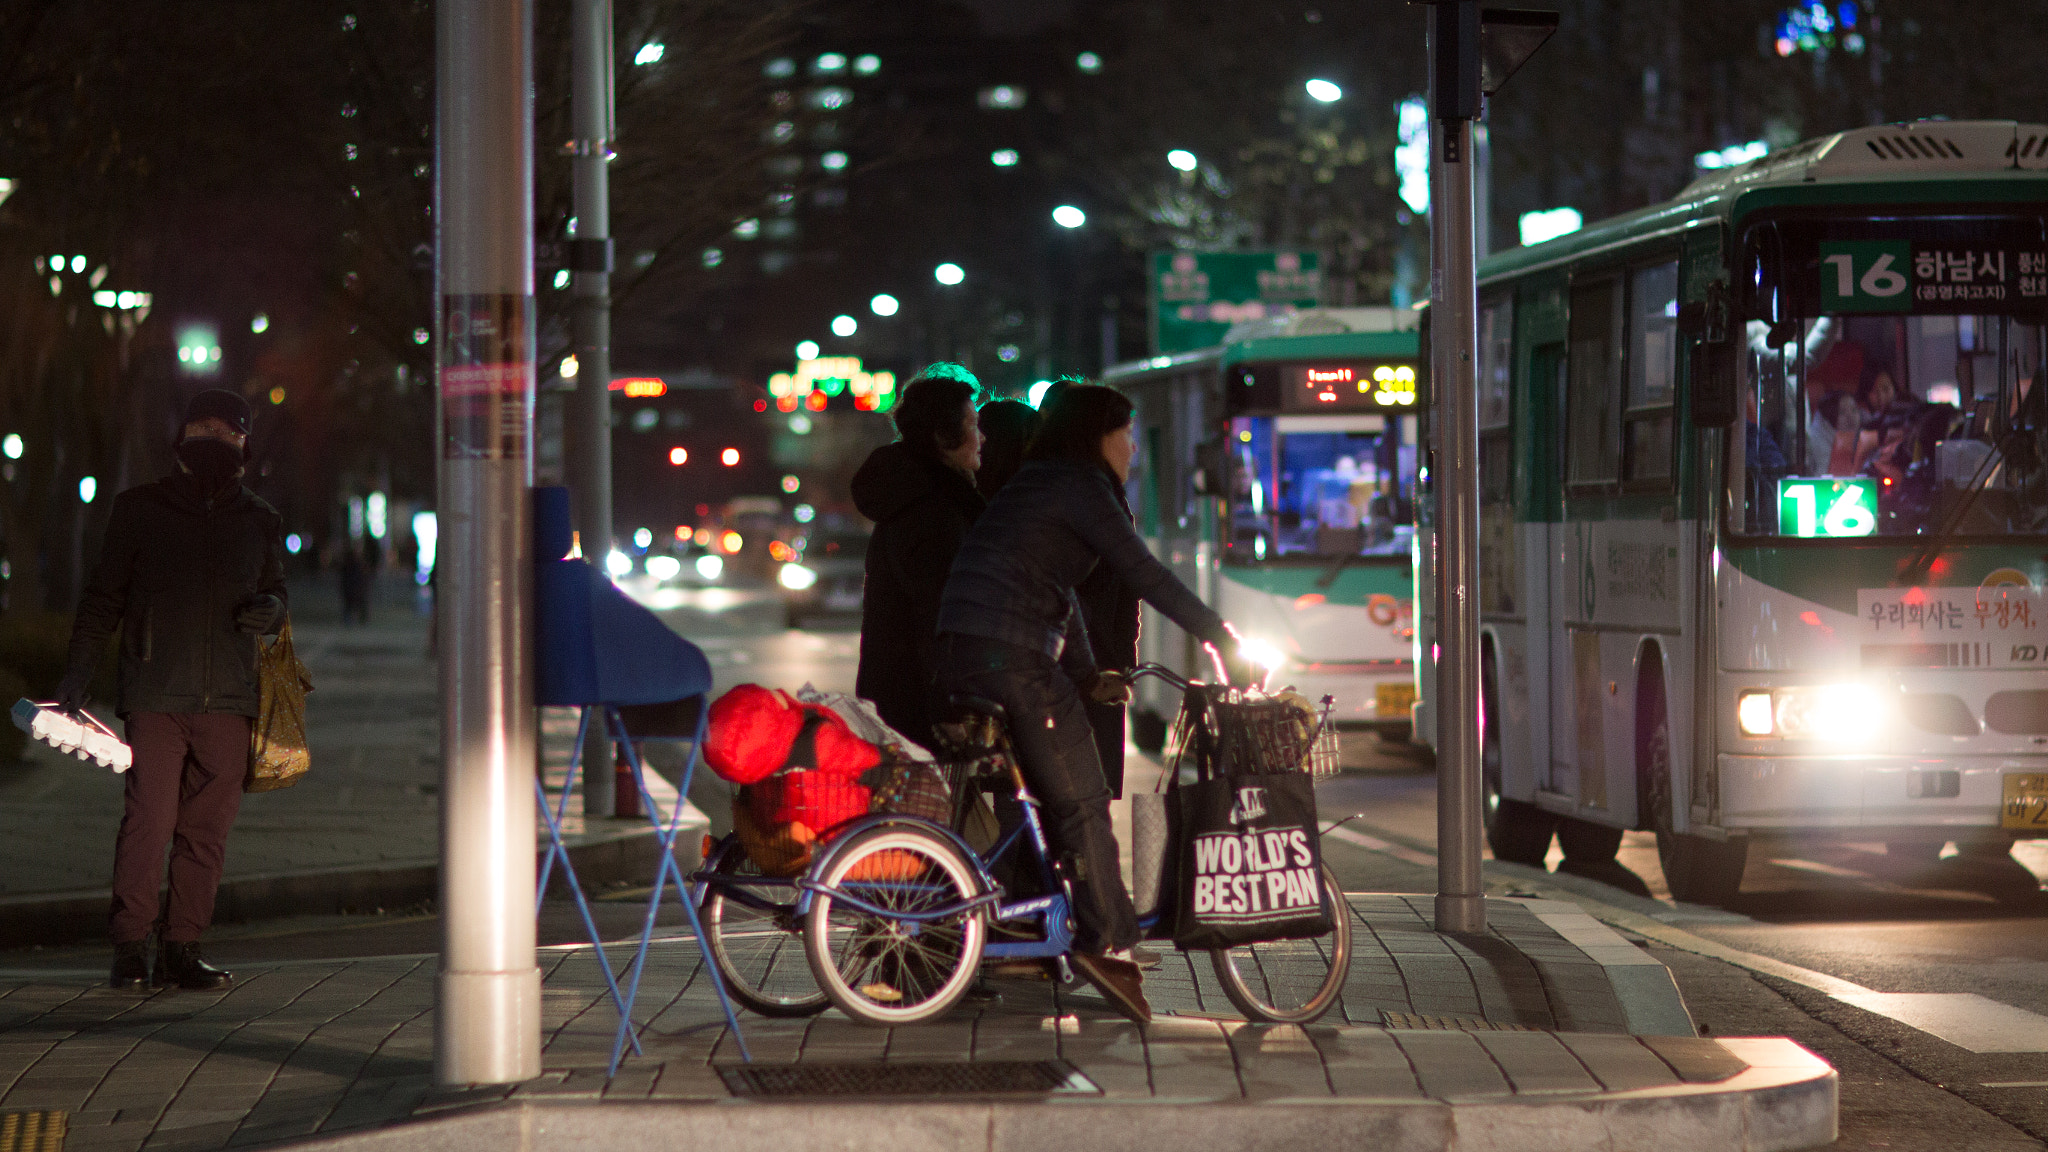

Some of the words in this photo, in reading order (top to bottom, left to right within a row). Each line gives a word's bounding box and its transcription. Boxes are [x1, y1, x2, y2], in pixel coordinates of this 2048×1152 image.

[1823, 254, 1907, 297] 16
[1915, 250, 2006, 282] 하남시
[1916, 284, 2006, 301] (공영차고지)
[1783, 483, 1875, 538] 16
[1868, 600, 1965, 630] 우리회사는
[1974, 599, 2036, 630] 무정차,
[1194, 830, 1312, 875] WORLD'S
[1194, 873, 1263, 913] BEST
[1266, 868, 1320, 909] PAN
